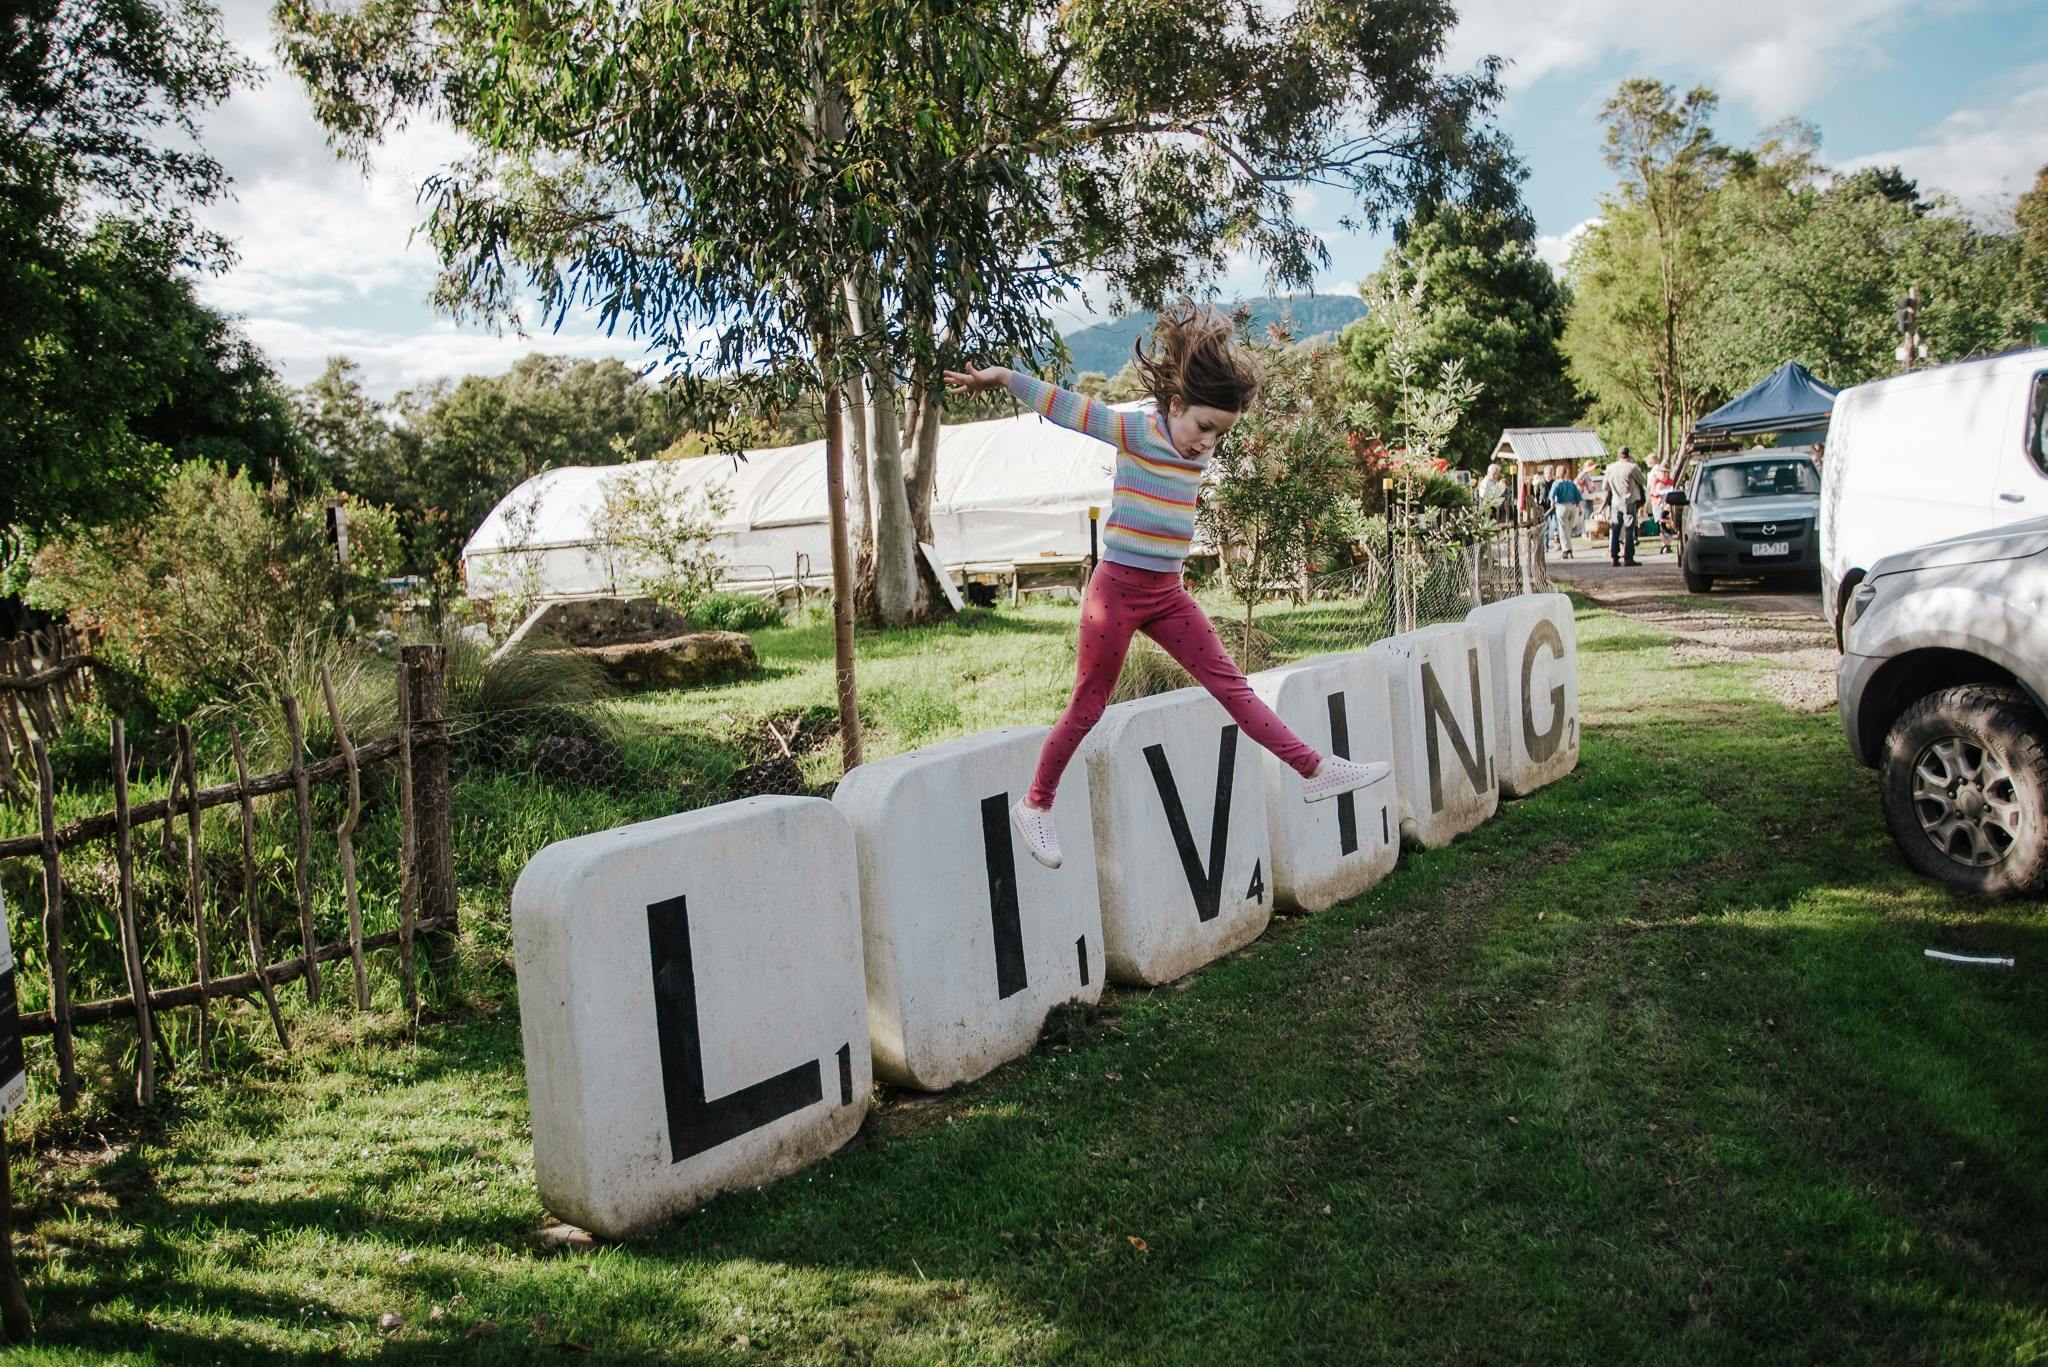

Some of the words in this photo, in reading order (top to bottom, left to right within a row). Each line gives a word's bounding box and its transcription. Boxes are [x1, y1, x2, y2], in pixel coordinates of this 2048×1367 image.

[1246, 857, 1264, 905] 4
[1075, 934, 1090, 986] 1
[834, 1042, 853, 1107] 1
